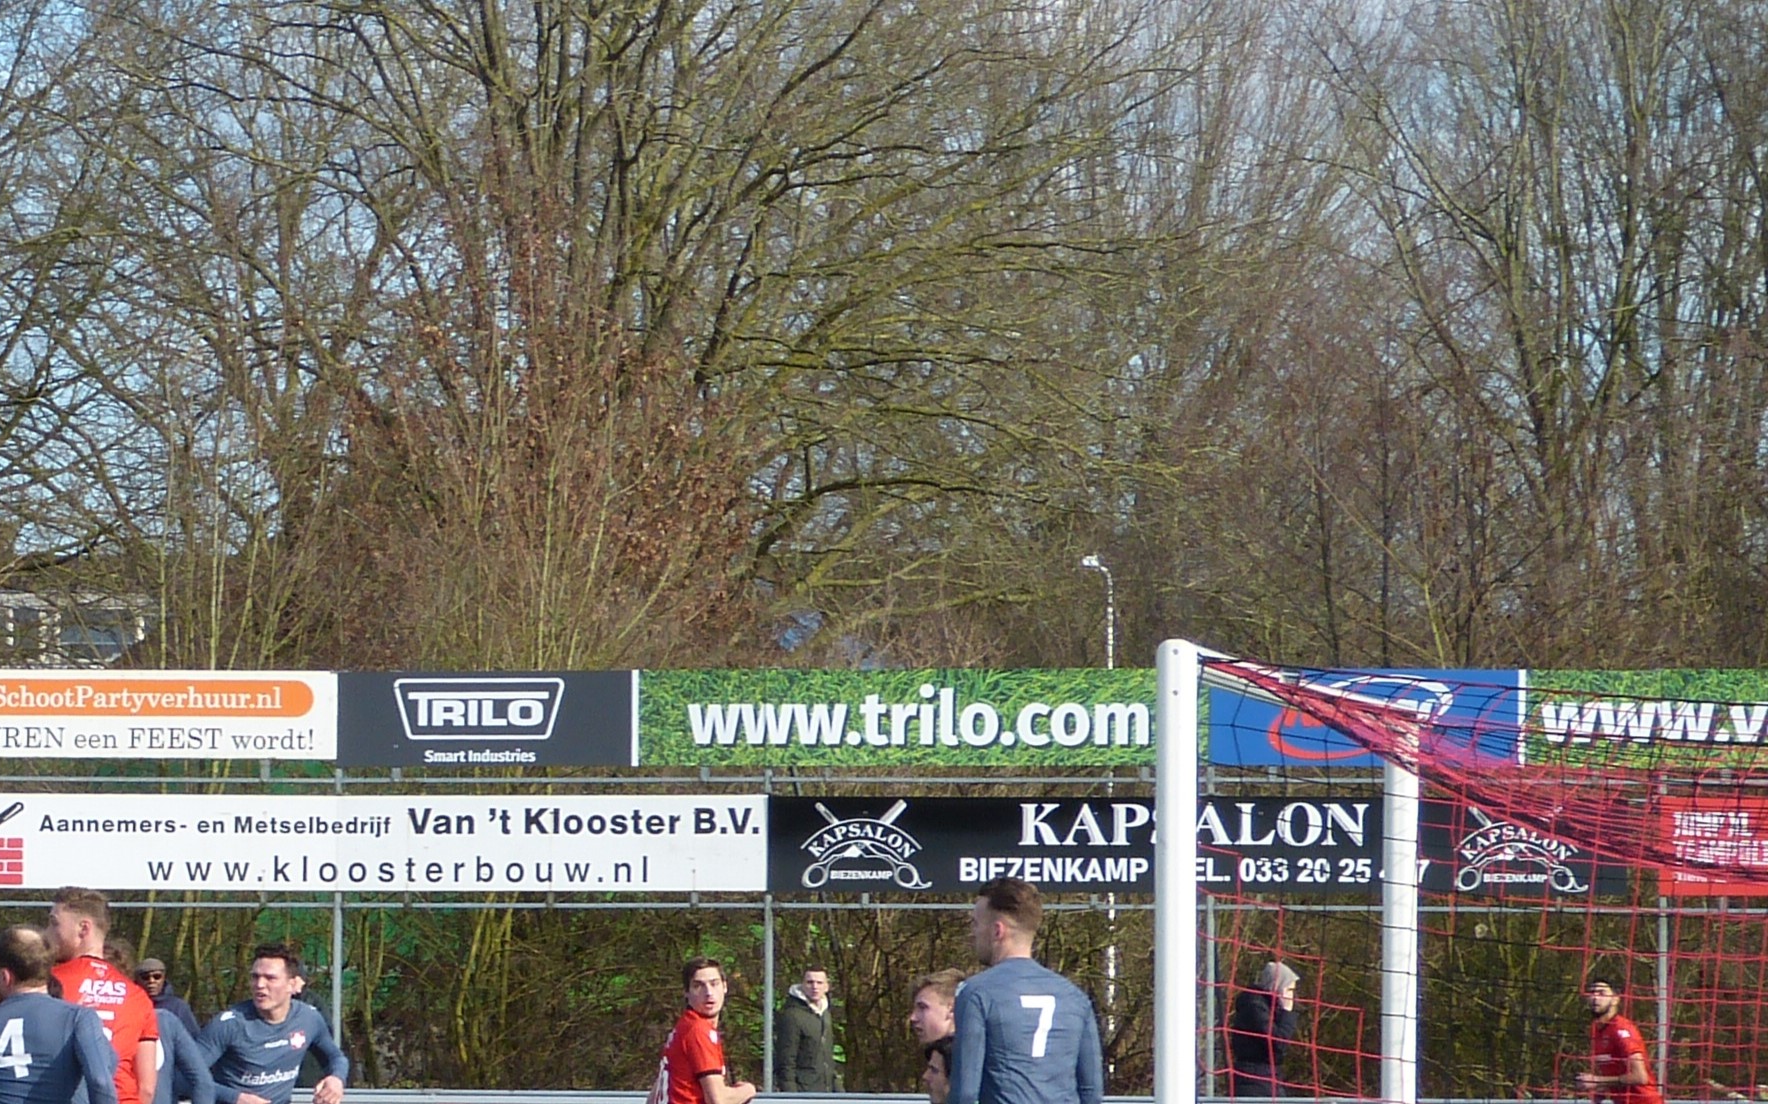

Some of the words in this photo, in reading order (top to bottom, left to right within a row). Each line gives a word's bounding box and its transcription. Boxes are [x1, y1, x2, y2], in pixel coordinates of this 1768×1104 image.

[408, 691, 550, 726] TRILO
[688, 684, 1152, 746] www.trilo.com
[1542, 701, 1768, 743] www.v
[74, 733, 117, 749] een
[128, 728, 222, 749] FEEST
[231, 728, 314, 750] wordt!
[424, 750, 466, 762] Smart
[468, 749, 536, 762] Industries
[197, 819, 225, 833] en
[234, 816, 392, 837] Metselbedrijf
[407, 808, 475, 835] Van
[524, 808, 680, 835] Klooster
[694, 808, 760, 835] B.V.
[1018, 803, 1369, 846] KAPALON
[808, 823, 916, 858] KAPSALON
[1460, 826, 1573, 860] KAPSALON
[148, 855, 649, 883] www.kloosterbouw.nl
[1240, 858, 1288, 882] 033
[1297, 859, 1330, 883] 20
[1338, 859, 1371, 883] 25
[79, 978, 126, 996] AFAS
[1020, 995, 1056, 1057] 7
